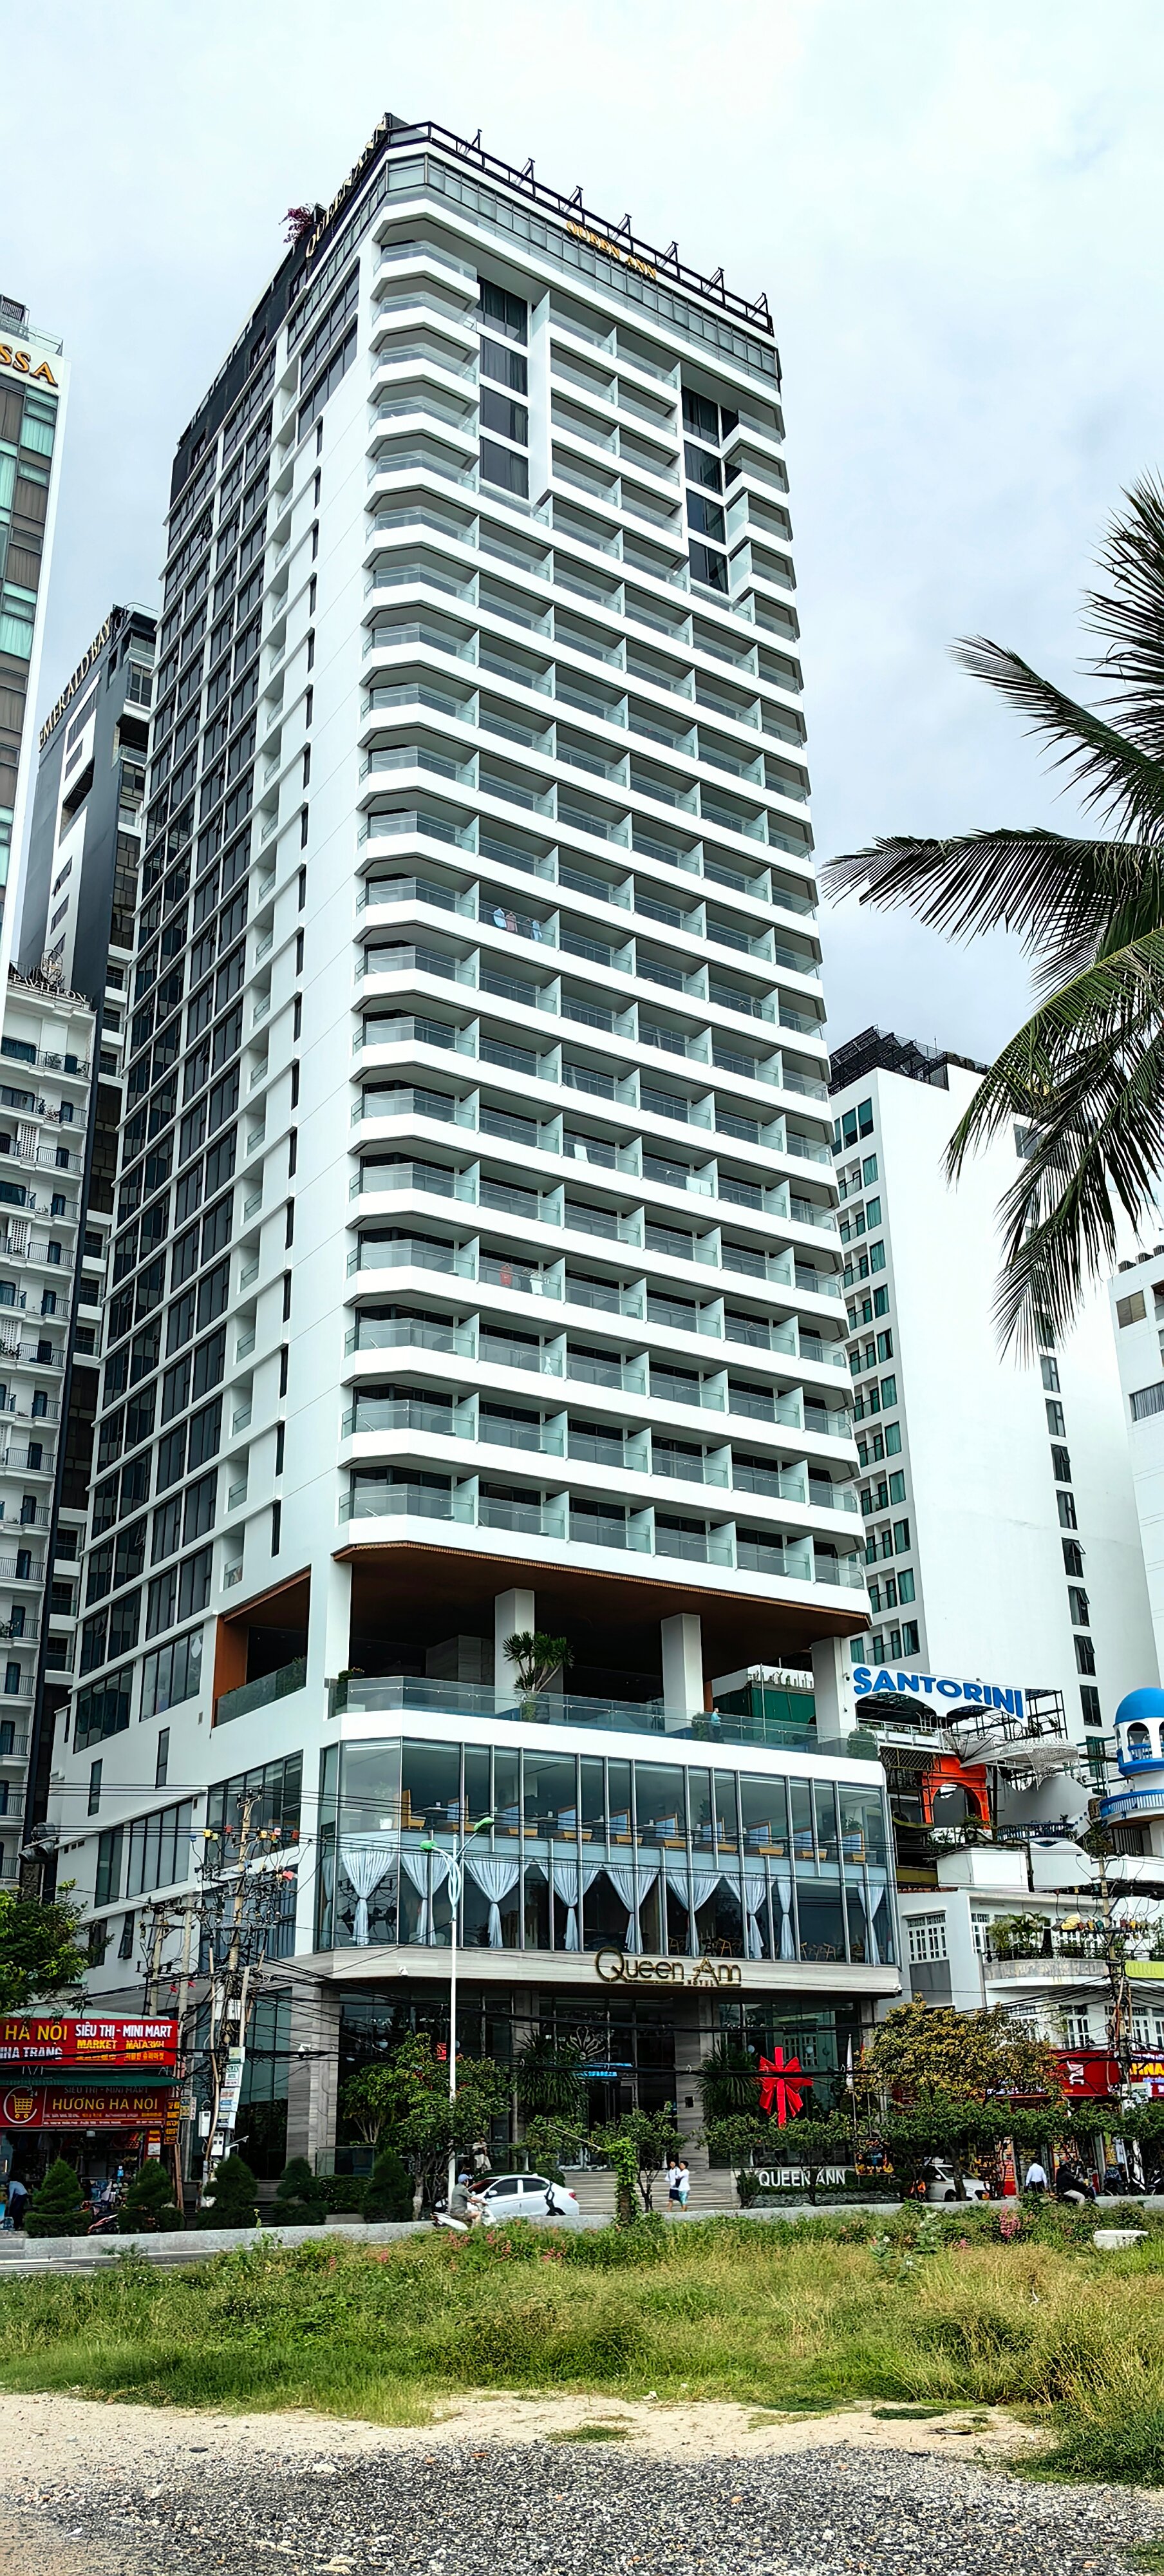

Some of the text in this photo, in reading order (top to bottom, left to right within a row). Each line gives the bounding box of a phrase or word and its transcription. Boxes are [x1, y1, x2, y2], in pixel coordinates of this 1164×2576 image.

[566, 220, 657, 279] QUEEN ANN
[39, 613, 111, 748] EMERALD BAY
[853, 1667, 1024, 1719] SANTORINI
[595, 1946, 684, 1985] Queen
[75, 2021, 97, 2037] SIÊU
[99, 2025, 115, 2040] THỊ
[122, 2025, 144, 2038] MINI
[146, 2025, 173, 2038] MART
[77, 2039, 118, 2049] MARKET
[758, 2168, 846, 2187] QUEEN ANN
